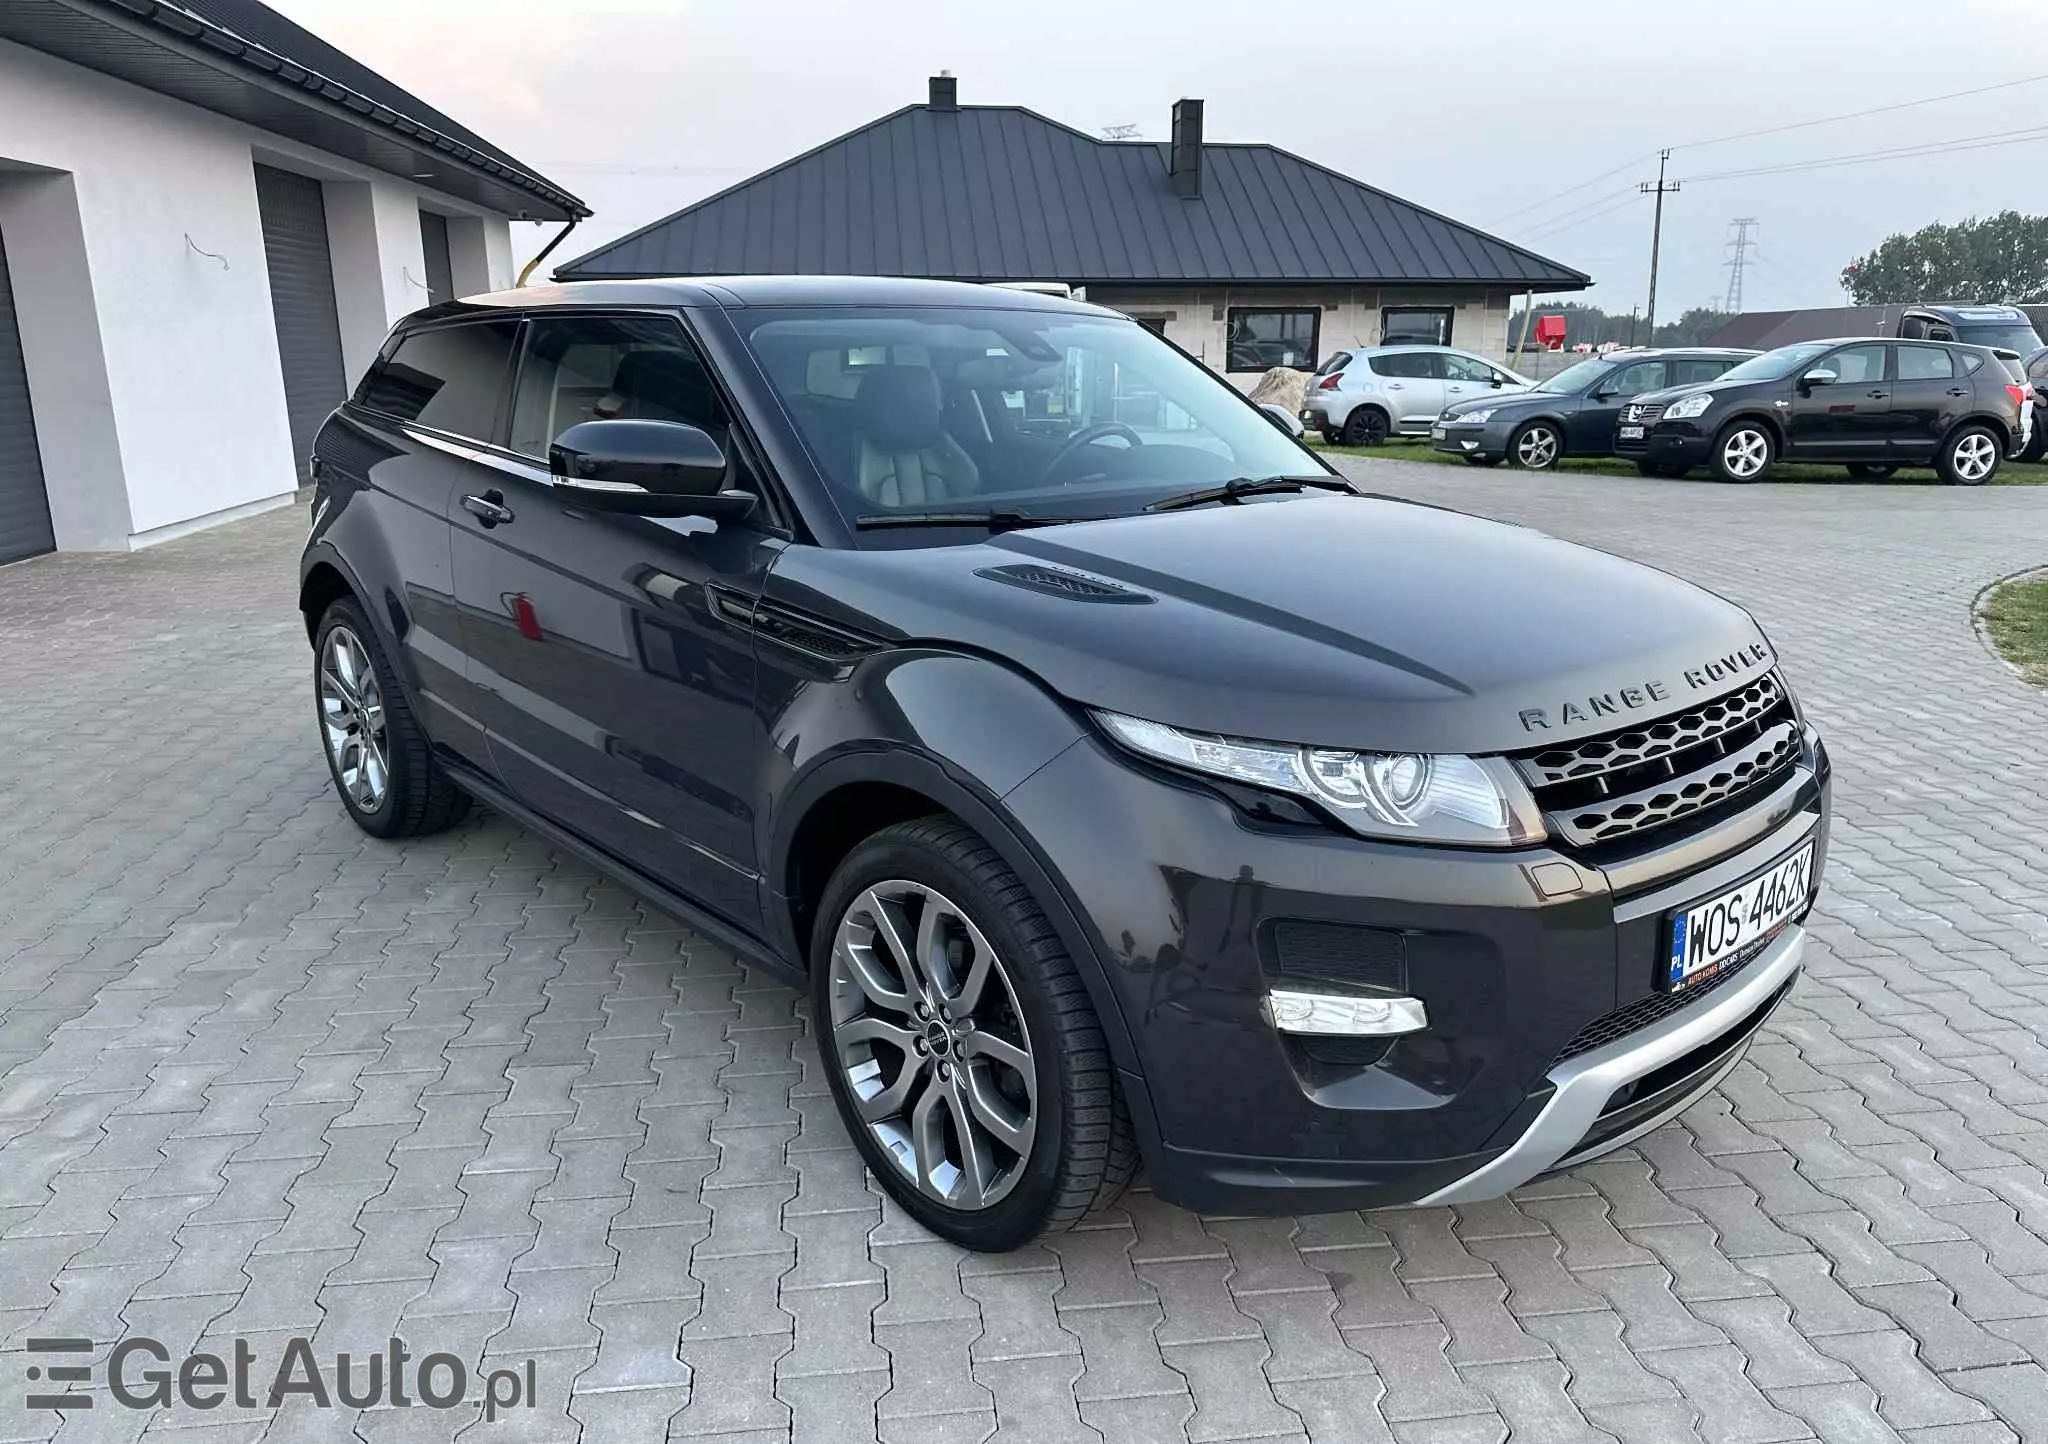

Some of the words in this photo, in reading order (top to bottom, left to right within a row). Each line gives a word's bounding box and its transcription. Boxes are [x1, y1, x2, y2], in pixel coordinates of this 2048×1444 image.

[1518, 679, 1672, 732] RANGE
[1683, 642, 1768, 689] ROVER
[1688, 894, 1742, 968] WOS
[1749, 848, 1811, 930] 4462K
[1671, 954, 1682, 971] PL
